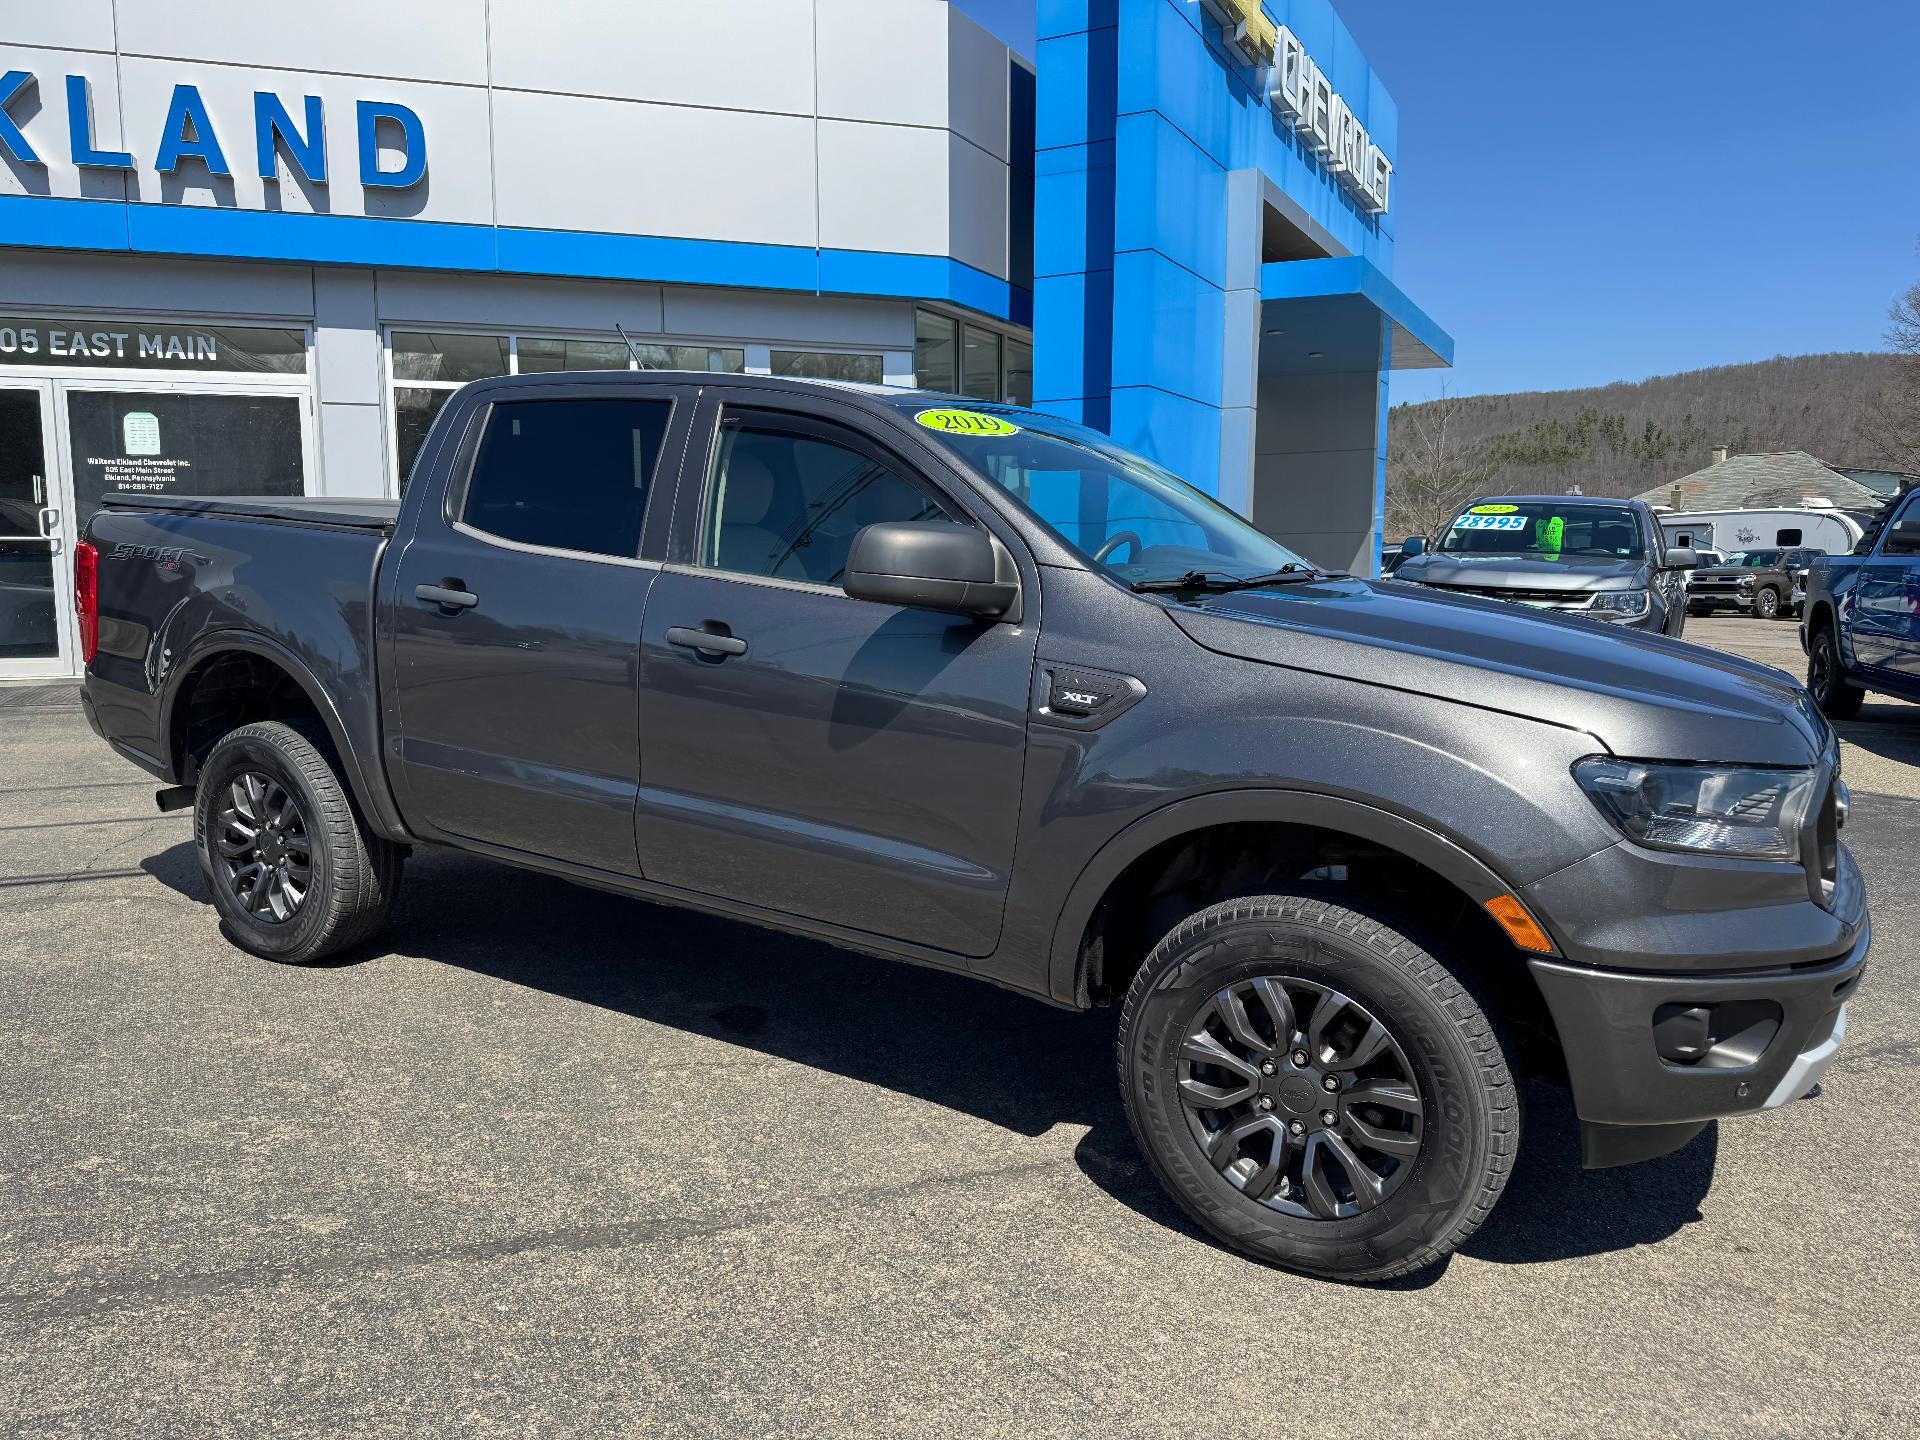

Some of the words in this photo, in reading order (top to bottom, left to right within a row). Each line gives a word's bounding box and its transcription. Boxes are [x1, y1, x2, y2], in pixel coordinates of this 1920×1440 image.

[1269, 24, 1393, 214] CHEVROLET
[0, 327, 39, 354] 05
[49, 330, 129, 358] EAST
[138, 333, 217, 361] MAIN
[935, 414, 1001, 431] 2019
[87, 457, 116, 466] Walters
[116, 458, 142, 466] Elkland
[143, 458, 177, 467] Chevrolet
[177, 459, 191, 467] Inc.
[119, 466, 135, 474] East
[135, 466, 153, 474] Main
[153, 466, 175, 474] Street
[104, 474, 131, 482] Elkland,
[131, 474, 176, 483] Pennsylvania
[1455, 516, 1525, 529] 28995
[106, 543, 194, 562] SPORT
[1061, 690, 1098, 705] XLT
